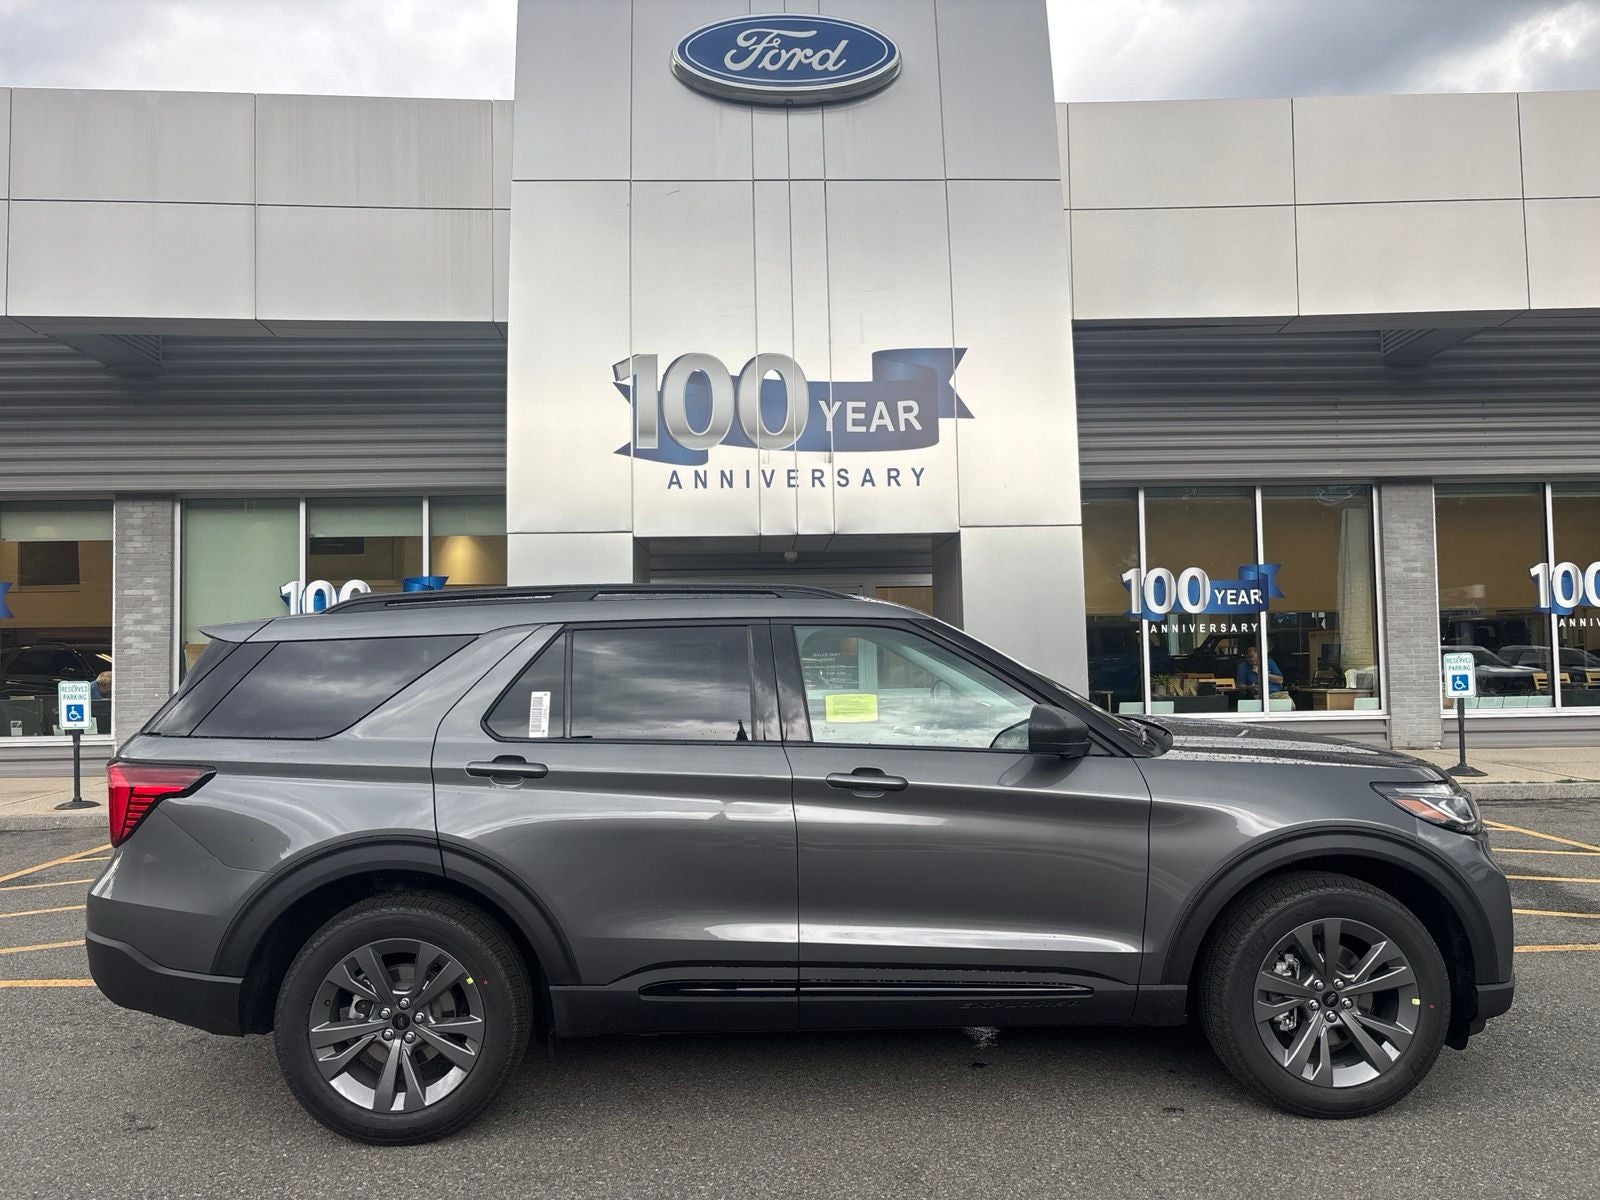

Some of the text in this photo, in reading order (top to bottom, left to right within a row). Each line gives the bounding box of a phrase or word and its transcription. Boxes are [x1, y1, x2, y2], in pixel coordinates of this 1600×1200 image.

[724, 28, 849, 72] Ford
[612, 352, 922, 450] 100 YEAR
[667, 467, 925, 490] ANNIVERSARY
[1121, 566, 1263, 614] 100 YEAR
[1150, 623, 1258, 633] ANNIVERSARY
[61, 685, 88, 693] RESERVED
